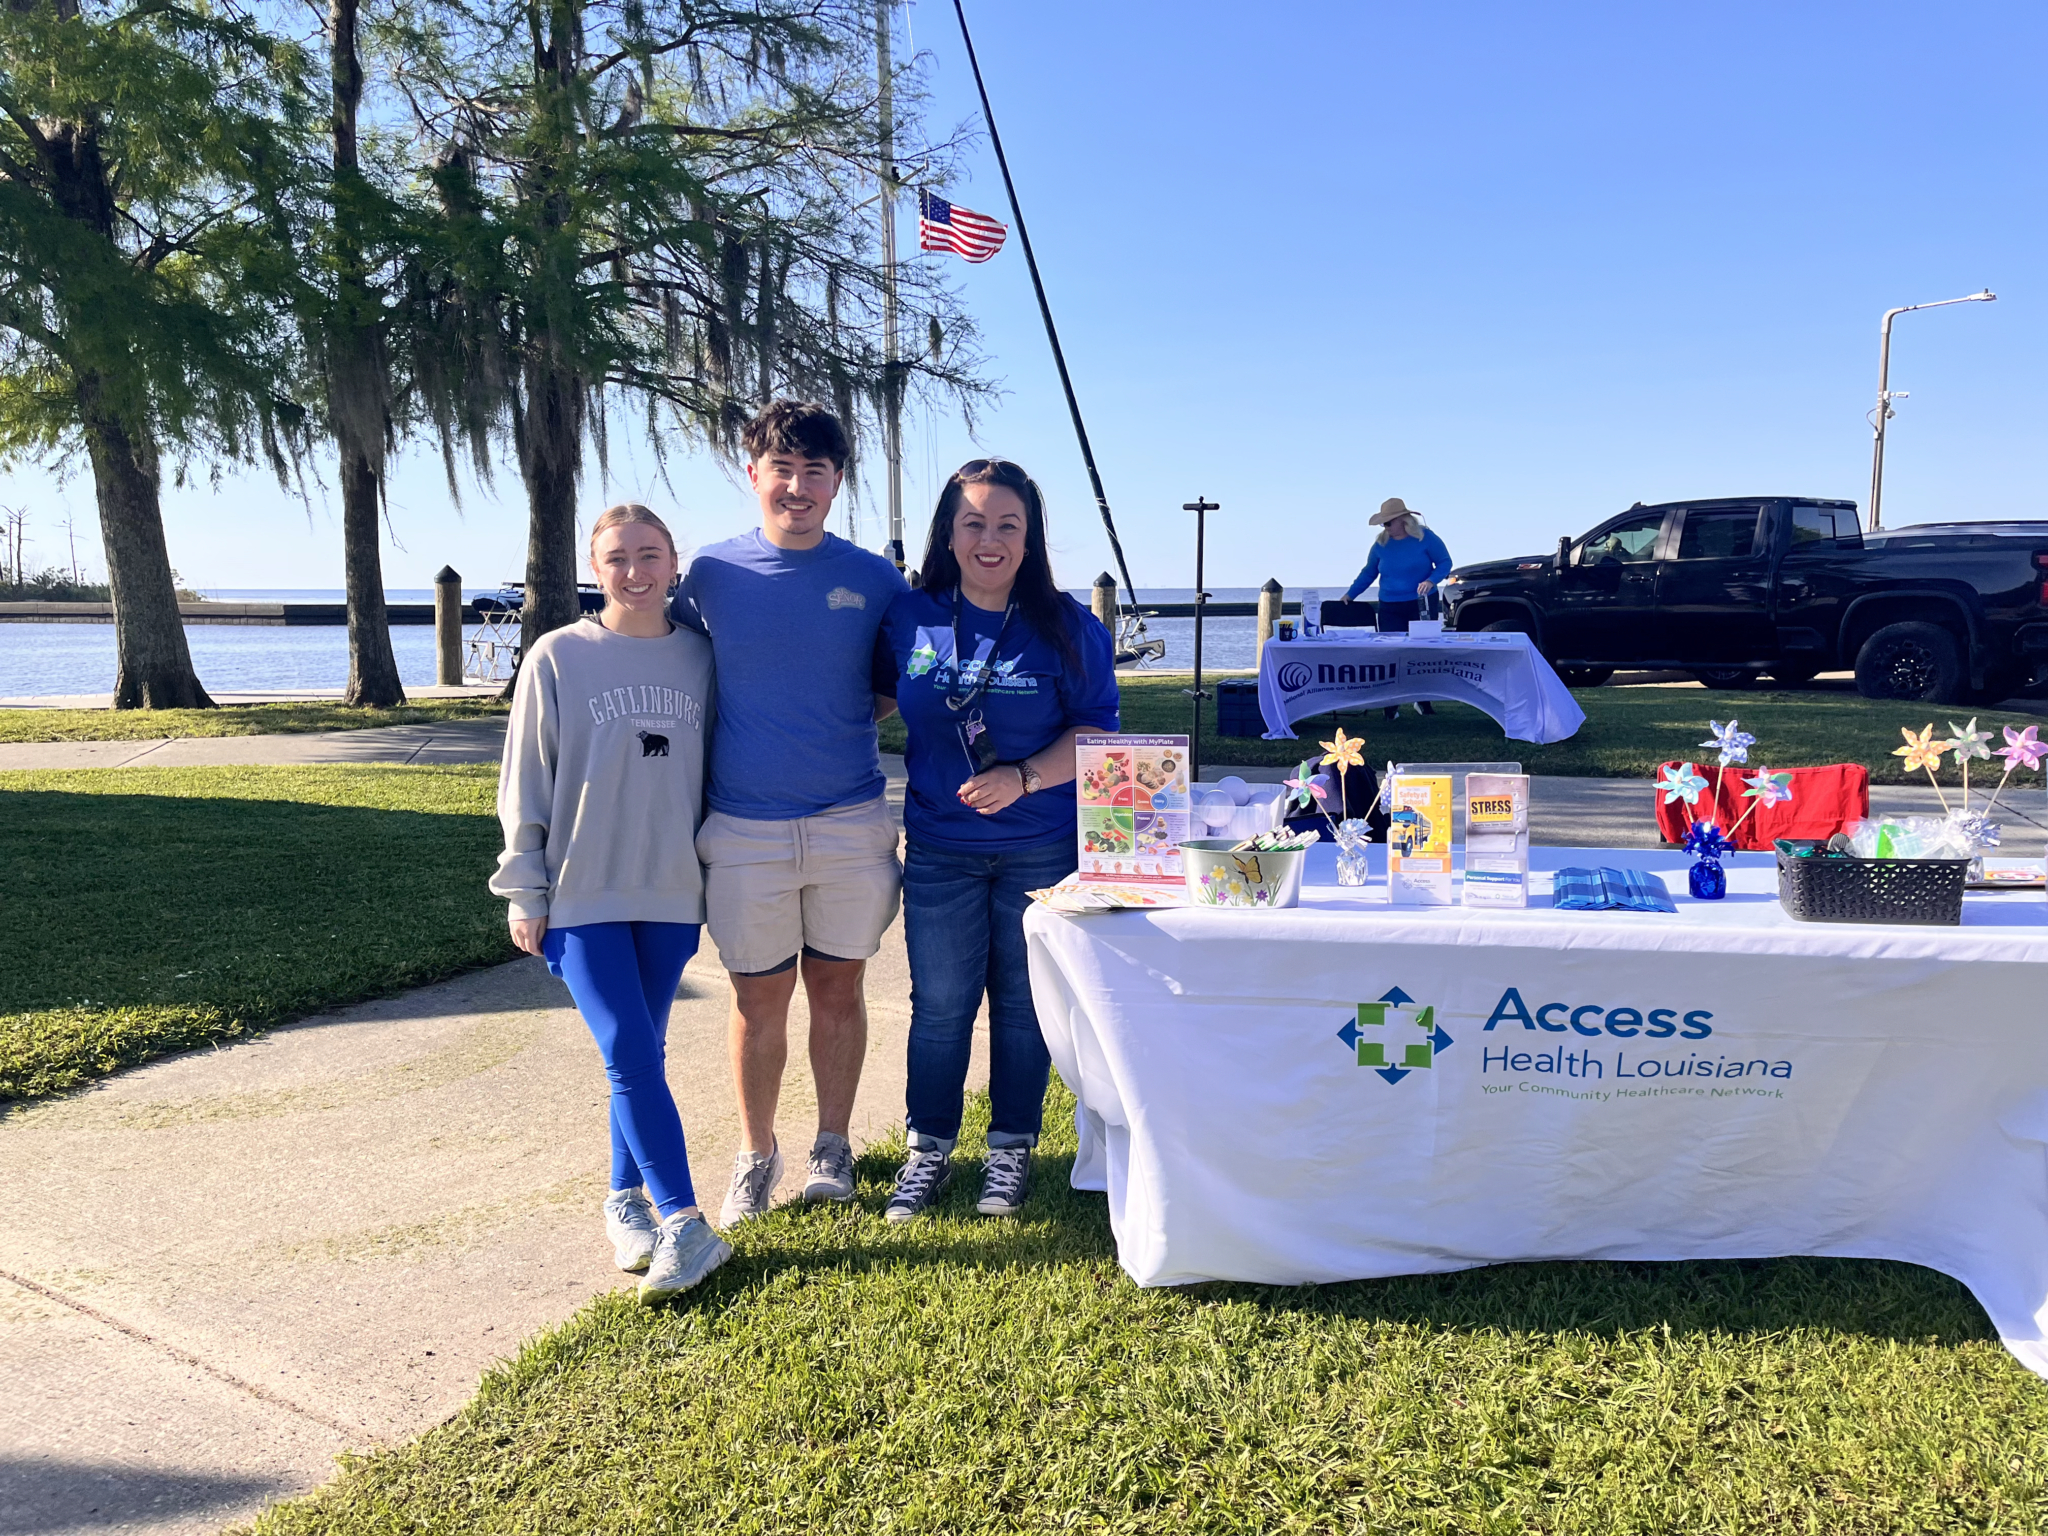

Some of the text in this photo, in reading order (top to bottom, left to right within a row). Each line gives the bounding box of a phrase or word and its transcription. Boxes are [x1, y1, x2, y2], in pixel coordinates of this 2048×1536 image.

[940, 659, 1014, 673] Accss
[1406, 659, 1487, 671] Southeast
[934, 671, 1038, 688] Helth ouisiana
[1317, 662, 1397, 684] NAMI
[1406, 666, 1483, 683] Louisiana
[1306, 686, 1335, 695] Alliance
[588, 684, 701, 731] GATLINBURG
[629, 718, 677, 729] TENNESSEE
[1086, 738, 1107, 746] Eating
[1107, 738, 1132, 746] Healthy
[1148, 738, 1174, 746] MyPlate
[1399, 791, 1420, 799] Safety
[1471, 800, 1511, 814] STRESS
[1483, 987, 1714, 1040] Access
[1483, 1045, 1793, 1079] Health Louisiana
[1482, 1081, 1785, 1102] Your Community Healthcare Network
